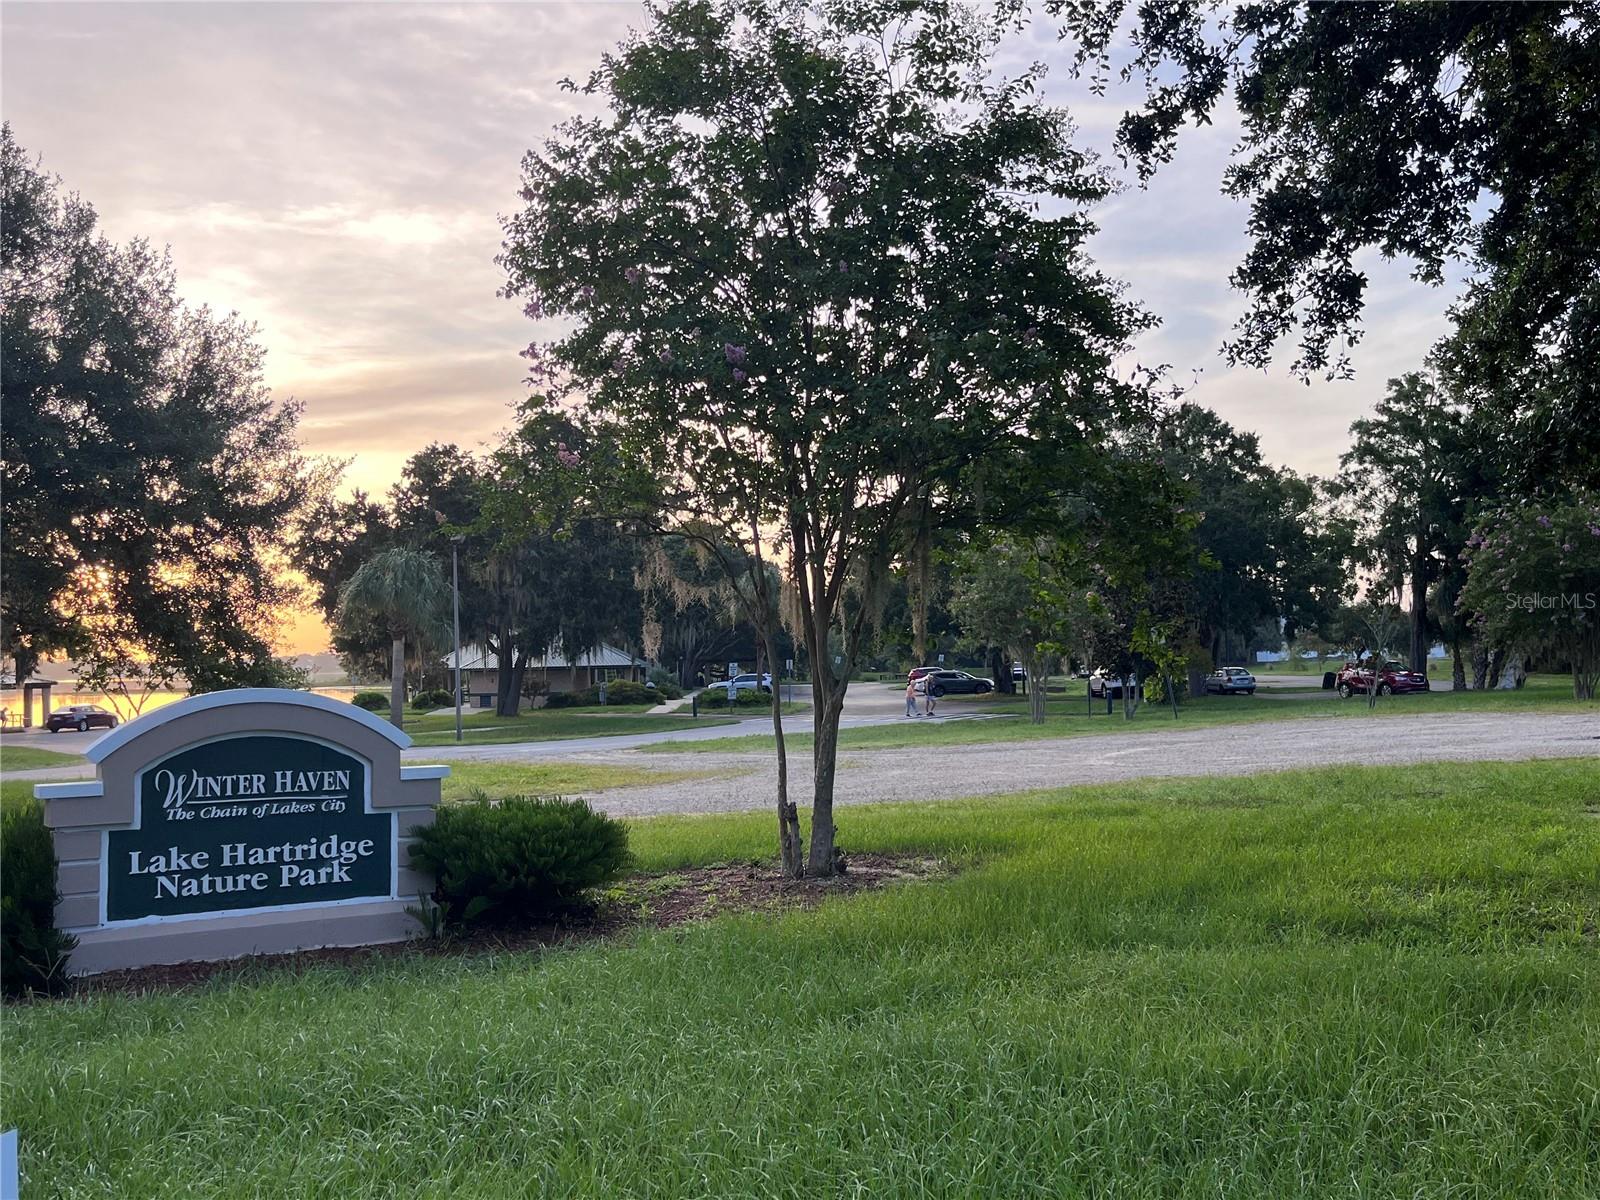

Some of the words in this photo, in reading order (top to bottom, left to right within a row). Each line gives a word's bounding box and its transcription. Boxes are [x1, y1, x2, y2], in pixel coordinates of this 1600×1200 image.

[155, 769, 266, 809] WINTER
[274, 770, 351, 793] HAVEN
[166, 808, 194, 821] The
[200, 805, 247, 820] Chain
[252, 802, 269, 819] of
[270, 801, 315, 815] Lakes
[321, 799, 346, 814] City
[128, 847, 209, 875] Lake
[221, 834, 374, 868] Hartridge
[154, 870, 268, 899] Nature
[280, 859, 352, 888] Park
